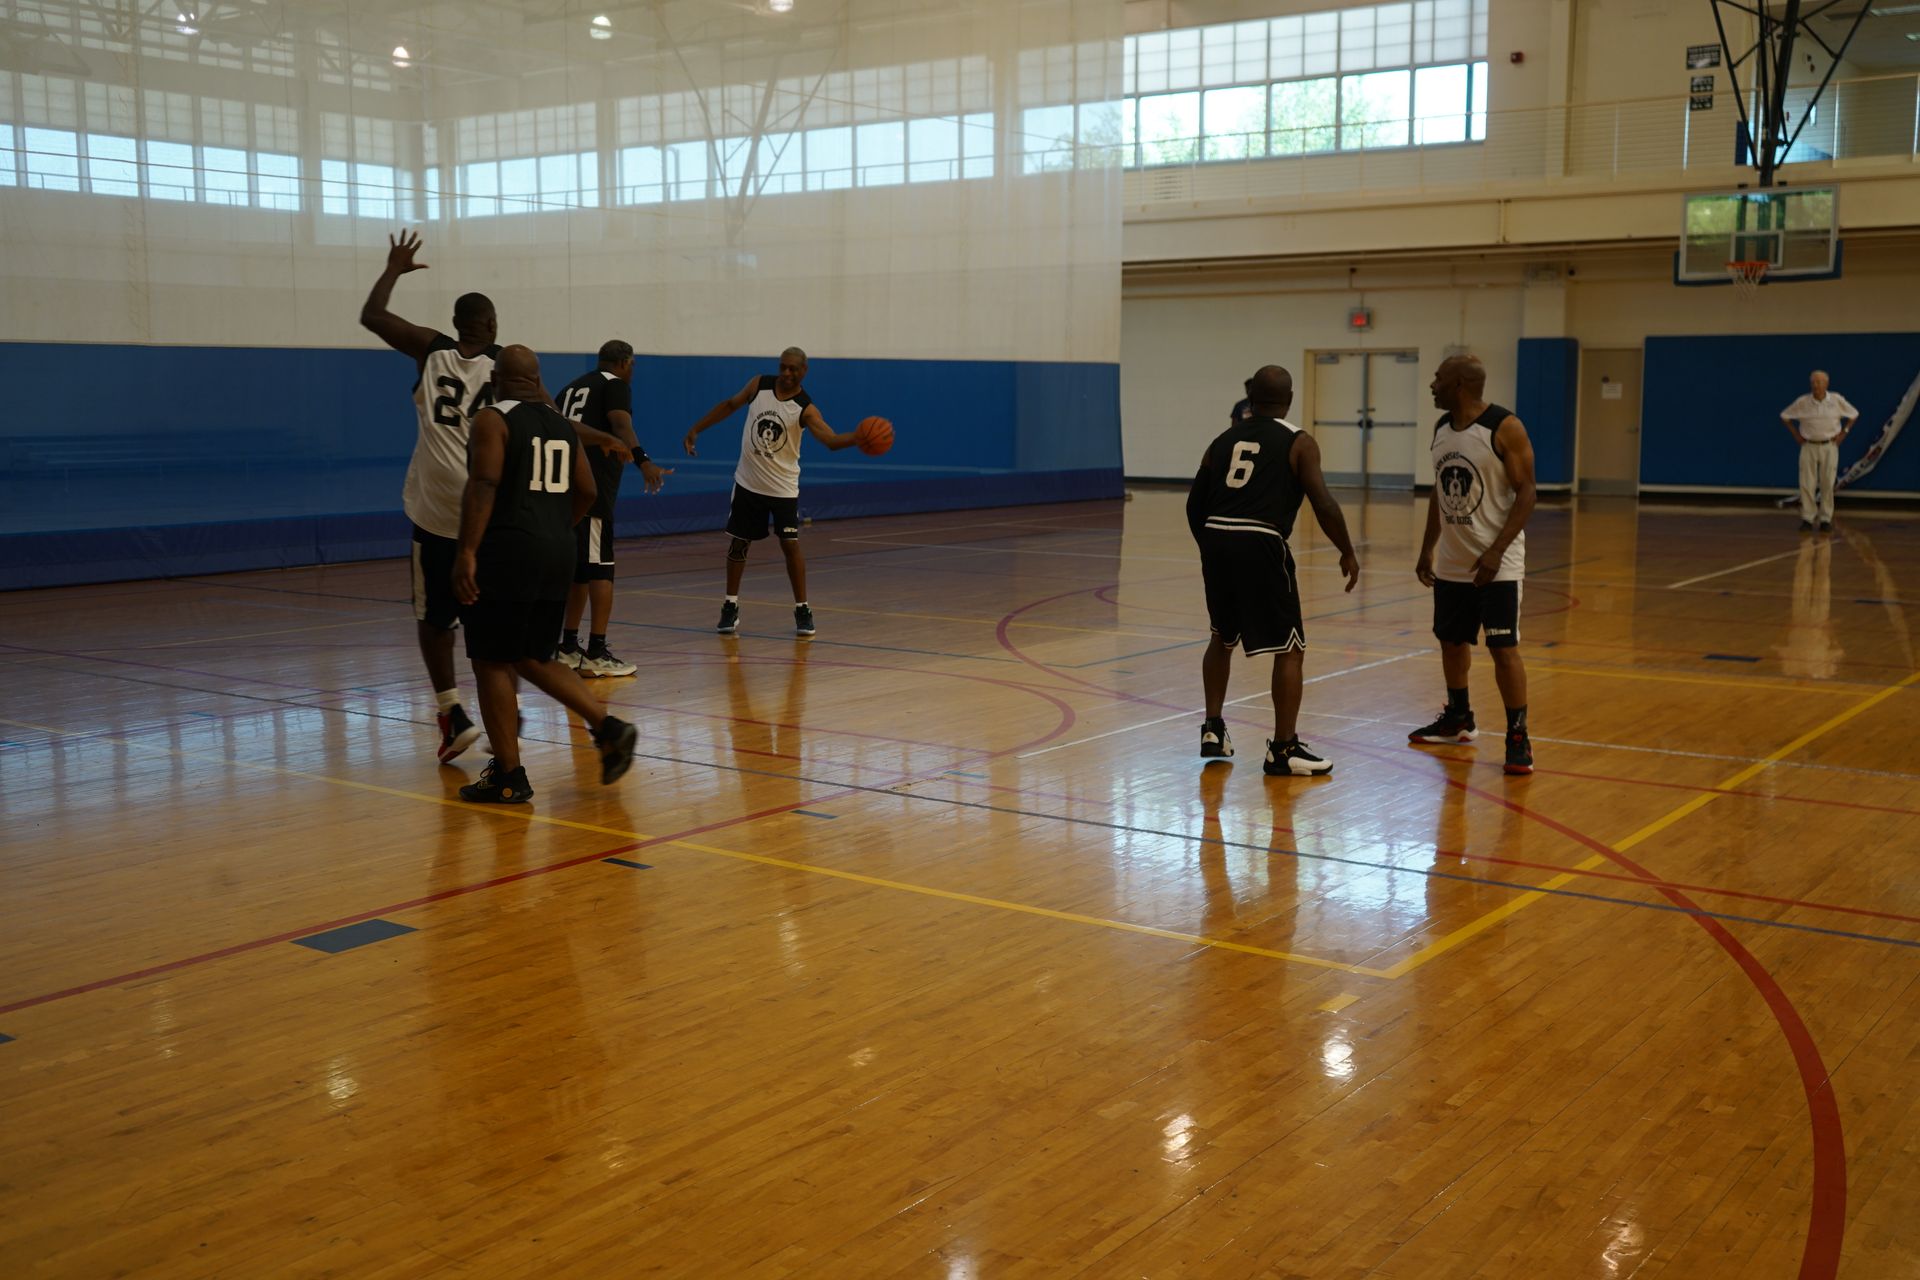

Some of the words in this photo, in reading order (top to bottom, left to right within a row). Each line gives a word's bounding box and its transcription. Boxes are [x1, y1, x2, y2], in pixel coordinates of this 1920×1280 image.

[434, 376, 495, 426] 24
[562, 387, 590, 422] 12
[529, 436, 570, 493] 10
[1225, 441, 1262, 489] 6
